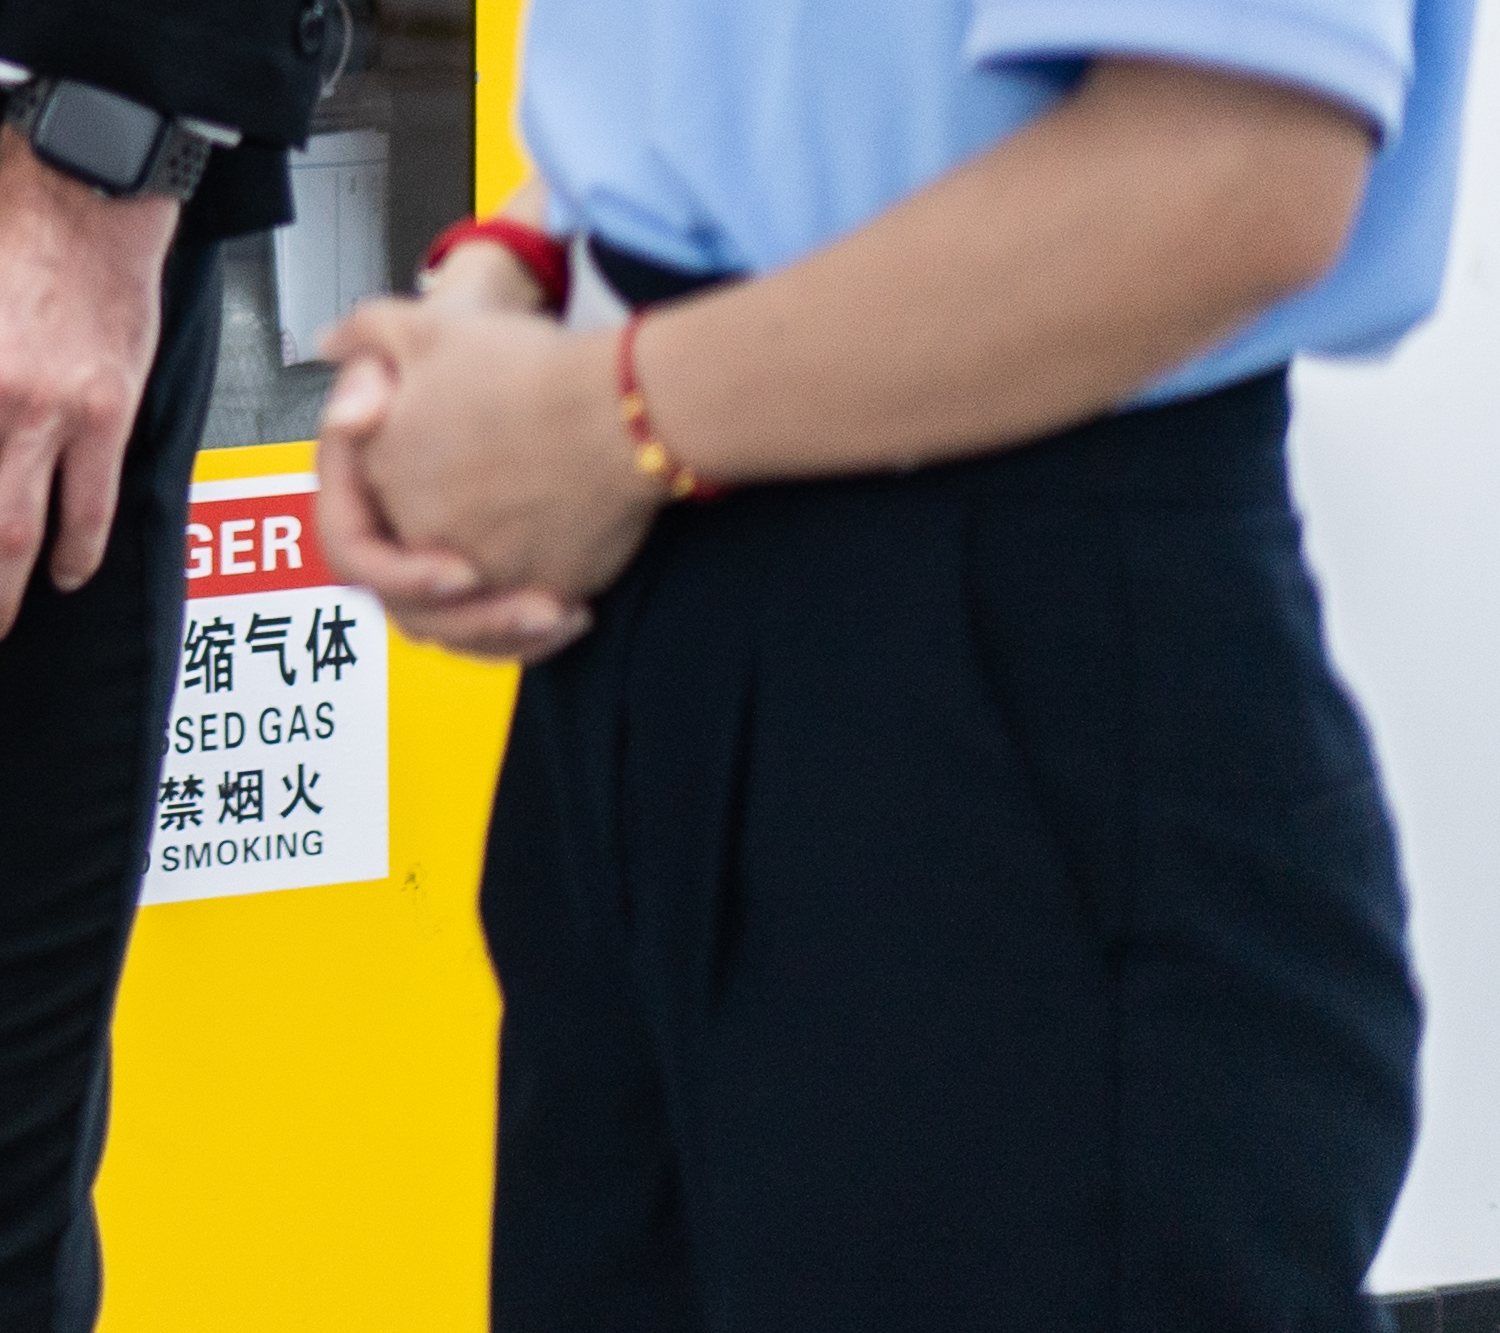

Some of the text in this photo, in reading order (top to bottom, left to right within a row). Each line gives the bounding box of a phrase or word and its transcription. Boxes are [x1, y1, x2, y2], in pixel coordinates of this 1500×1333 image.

[184, 604, 357, 693] 缩气体
[160, 701, 335, 755] SED GAS
[159, 764, 323, 831] 禁烟火
[161, 830, 324, 872] SMOKING
